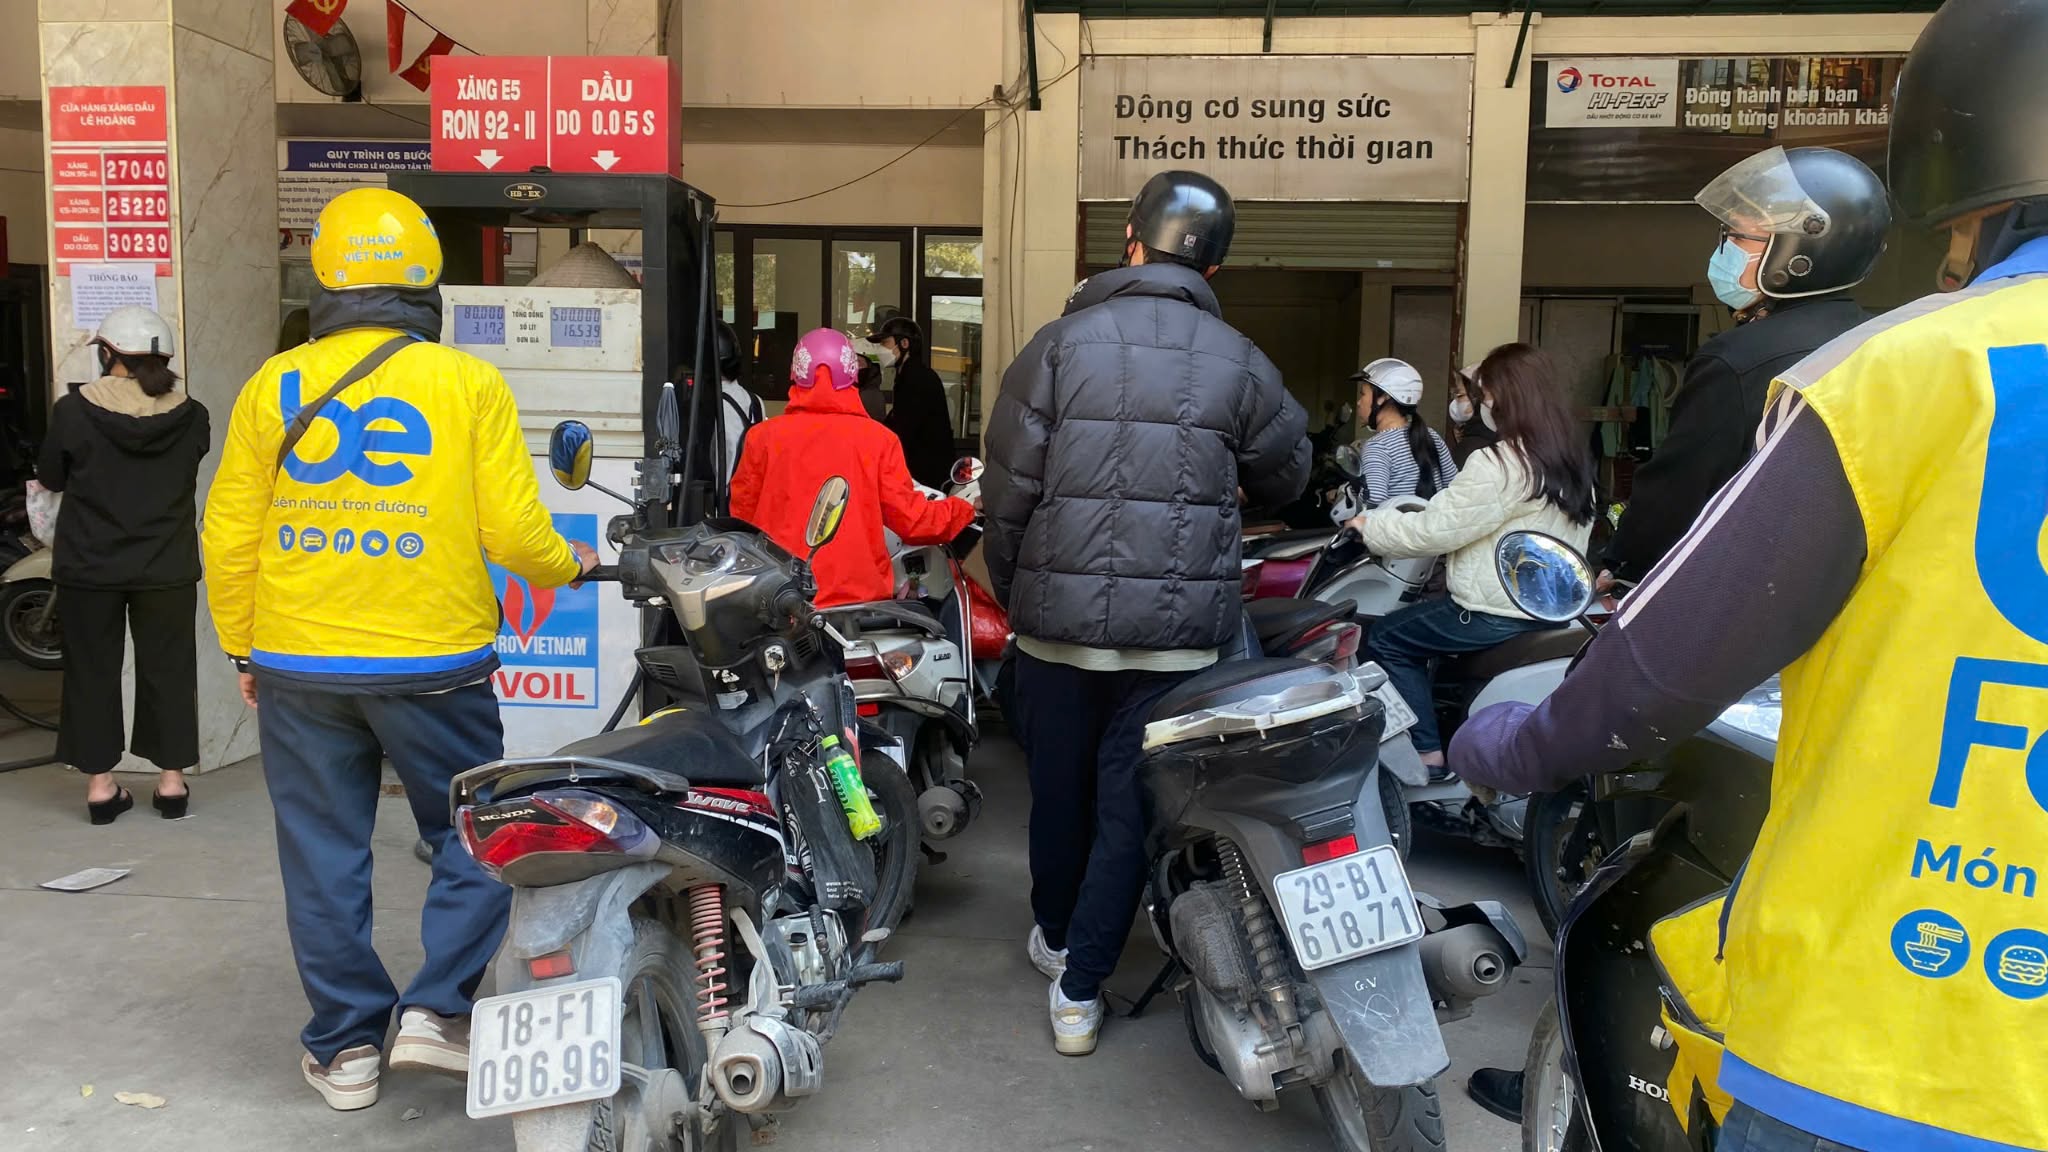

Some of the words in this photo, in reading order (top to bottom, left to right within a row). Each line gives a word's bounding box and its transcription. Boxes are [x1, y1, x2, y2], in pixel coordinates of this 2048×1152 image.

[457, 75, 497, 100] XĂNG
[501, 79, 521, 101] E5
[582, 70, 633, 102] DẦU
[1588, 74, 1656, 88] TOTAL
[81, 103, 106, 112] HÀNG
[135, 101, 155, 112] DẦU
[1587, 92, 1669, 109] HI-PERF
[1685, 84, 1731, 107] Đồng
[1736, 86, 1781, 104] hành
[1786, 86, 1819, 103] bên
[1824, 86, 1858, 106] bạn
[1115, 94, 1193, 124] Động
[1203, 97, 1240, 119] cơ
[1250, 99, 1325, 124] sung
[1336, 92, 1391, 119] sức
[1685, 111, 1732, 130] trong
[1737, 109, 1779, 128] từng
[1784, 108, 1849, 126] khoảnh
[1855, 104, 1890, 125] khắ
[80, 114, 94, 125] LÊ
[96, 115, 136, 125] HOÀNG
[442, 109, 480, 140] RON
[484, 110, 509, 140] 92
[556, 109, 581, 136] DO
[327, 150, 349, 160] QUY
[353, 149, 384, 160] TRÌNH
[387, 151, 400, 160] 05
[1114, 135, 1205, 160] Thách
[1217, 134, 1285, 160] thức
[1296, 134, 1355, 160] thời
[1366, 138, 1433, 165] gian
[106, 160, 165, 179] 27040
[381, 162, 406, 170] HOÀNG
[108, 197, 166, 216] 25220
[109, 233, 168, 253] 30230
[348, 236, 363, 248] TỰ
[367, 233, 396, 245] HÀO
[343, 250, 371, 263] VIỆT
[374, 250, 404, 261] NAM
[88, 272, 119, 281] THÔNG
[120, 272, 138, 281] BÁO
[280, 368, 433, 487] be
[300, 497, 337, 510] nhau
[342, 498, 370, 514] trọn
[374, 499, 428, 518] đường
[478, 808, 536, 821] HONDA
[1910, 838, 2037, 898] Món
[1295, 857, 1387, 915] 29-B1
[1299, 896, 1412, 960] 618.71
[497, 990, 593, 1050] 18-F1
[479, 1040, 609, 1106] 096.96
